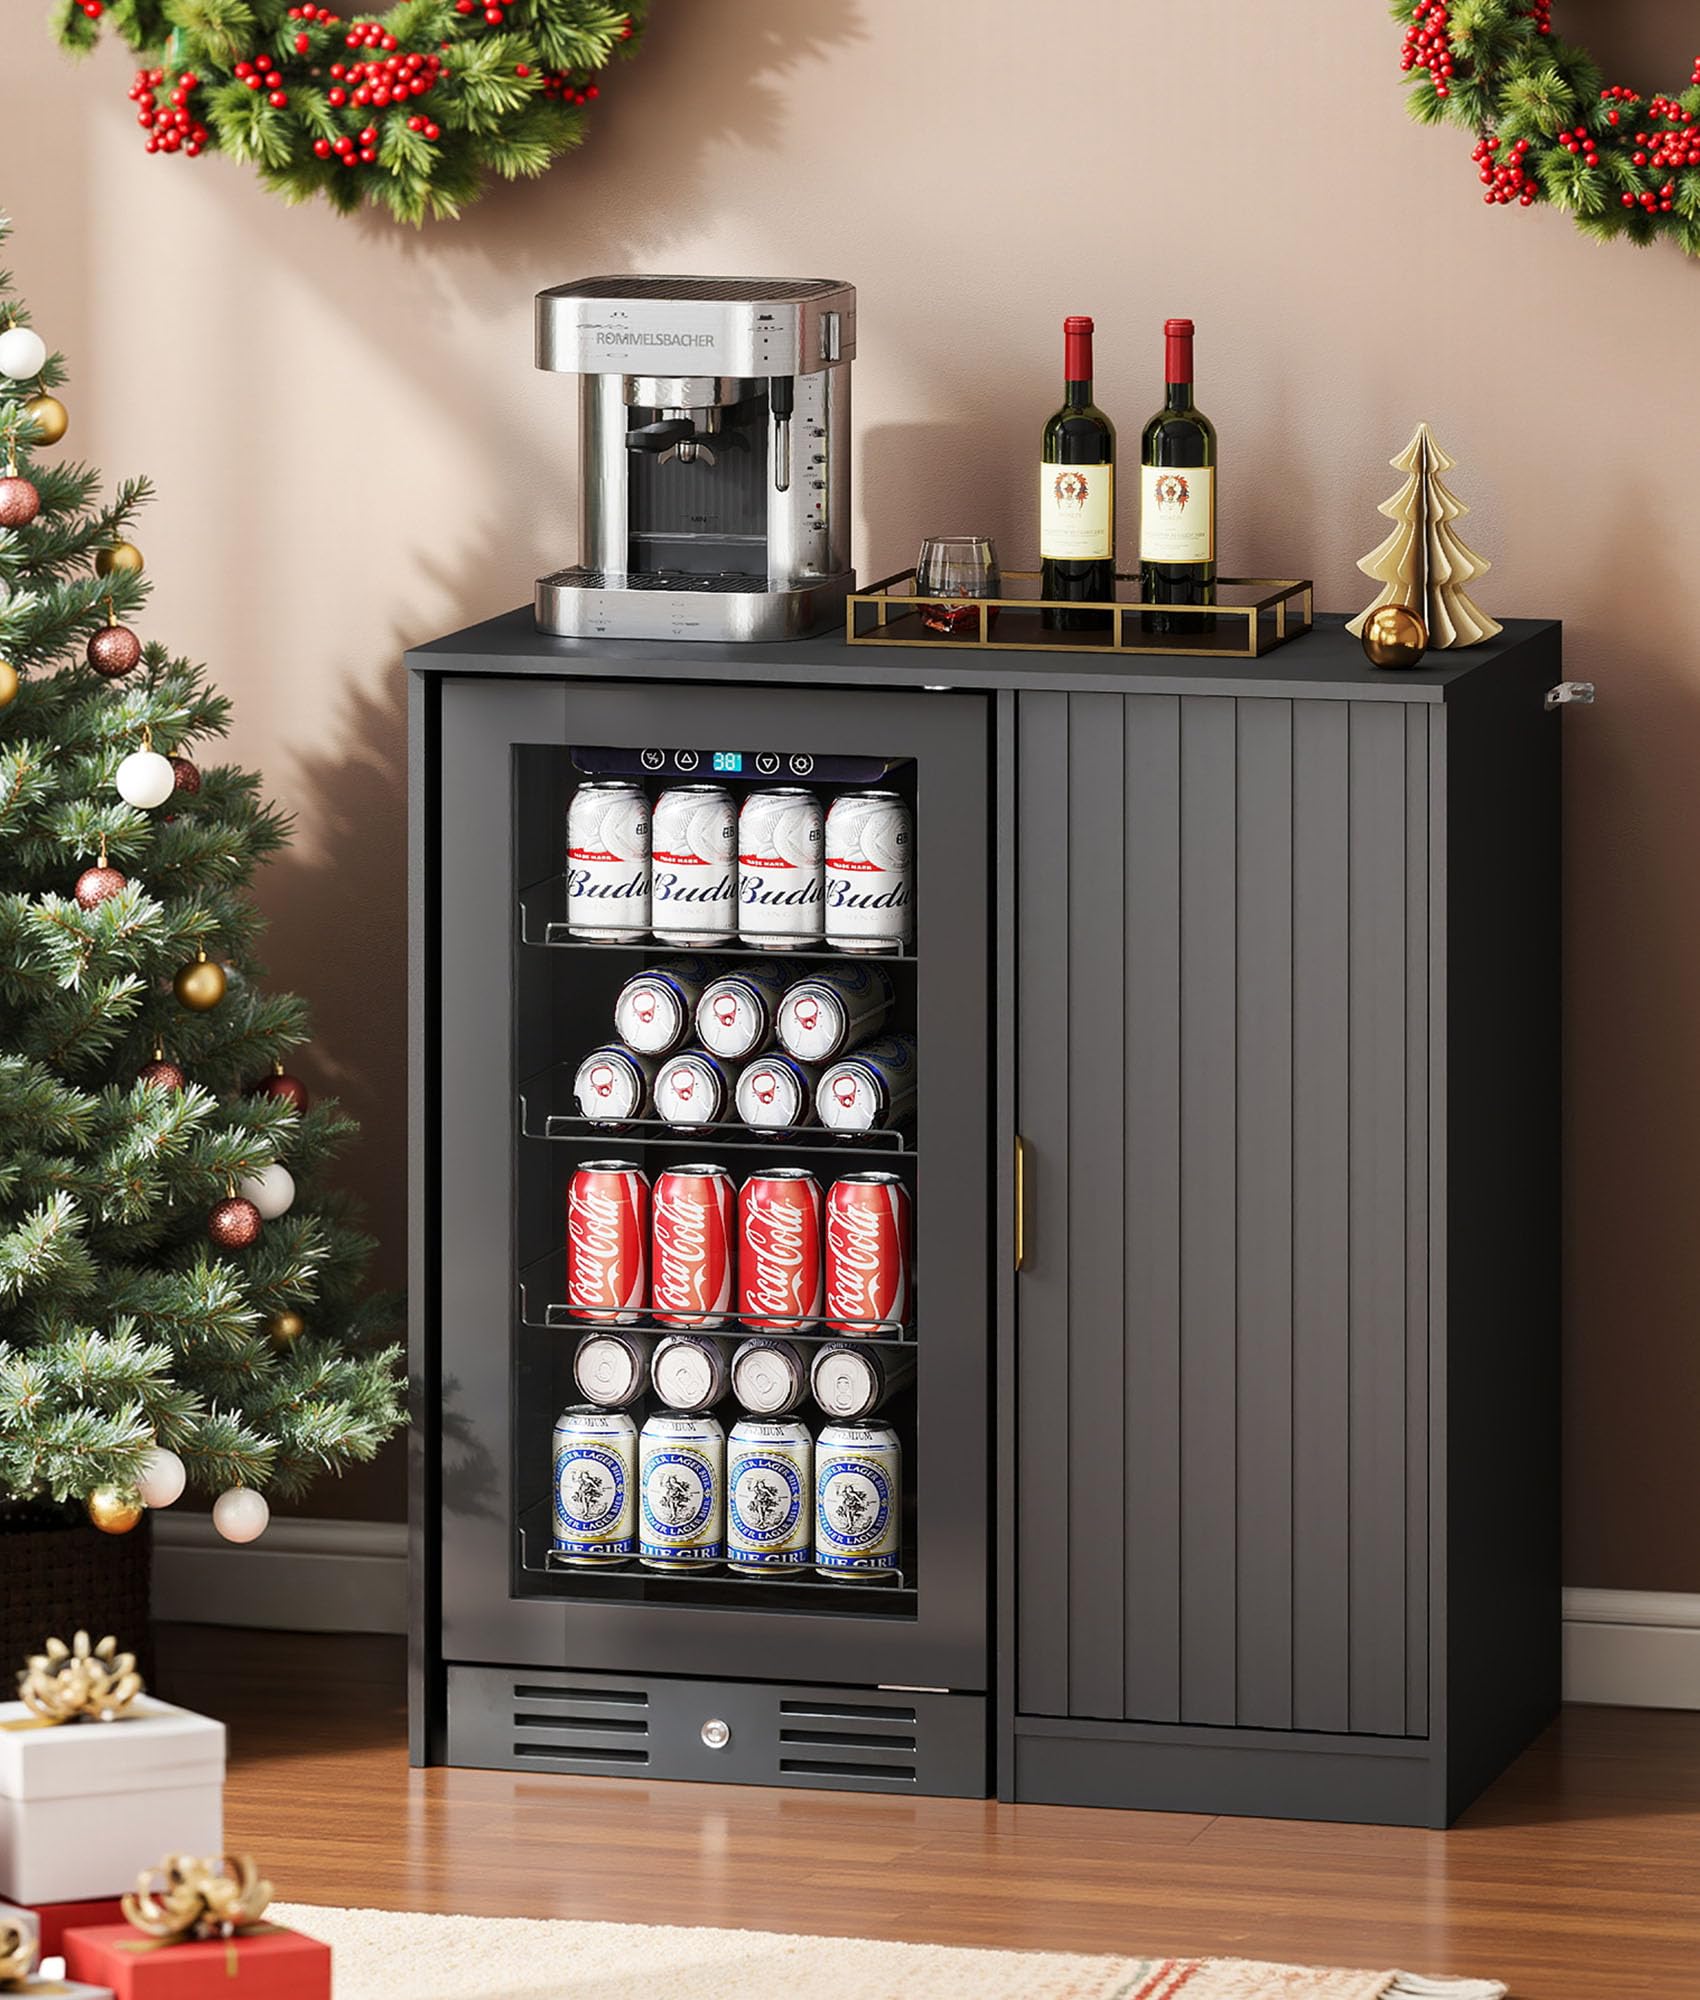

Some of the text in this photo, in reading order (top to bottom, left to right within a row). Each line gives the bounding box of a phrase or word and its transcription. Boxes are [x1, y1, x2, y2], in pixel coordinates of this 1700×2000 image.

[596, 332, 715, 347] ROMMELSBACHER
[583, 1451, 614, 1467] LAGER
[671, 1455, 702, 1471] LAGER
[759, 1460, 790, 1476] LAGER
[848, 1464, 879, 1481] LAGER
